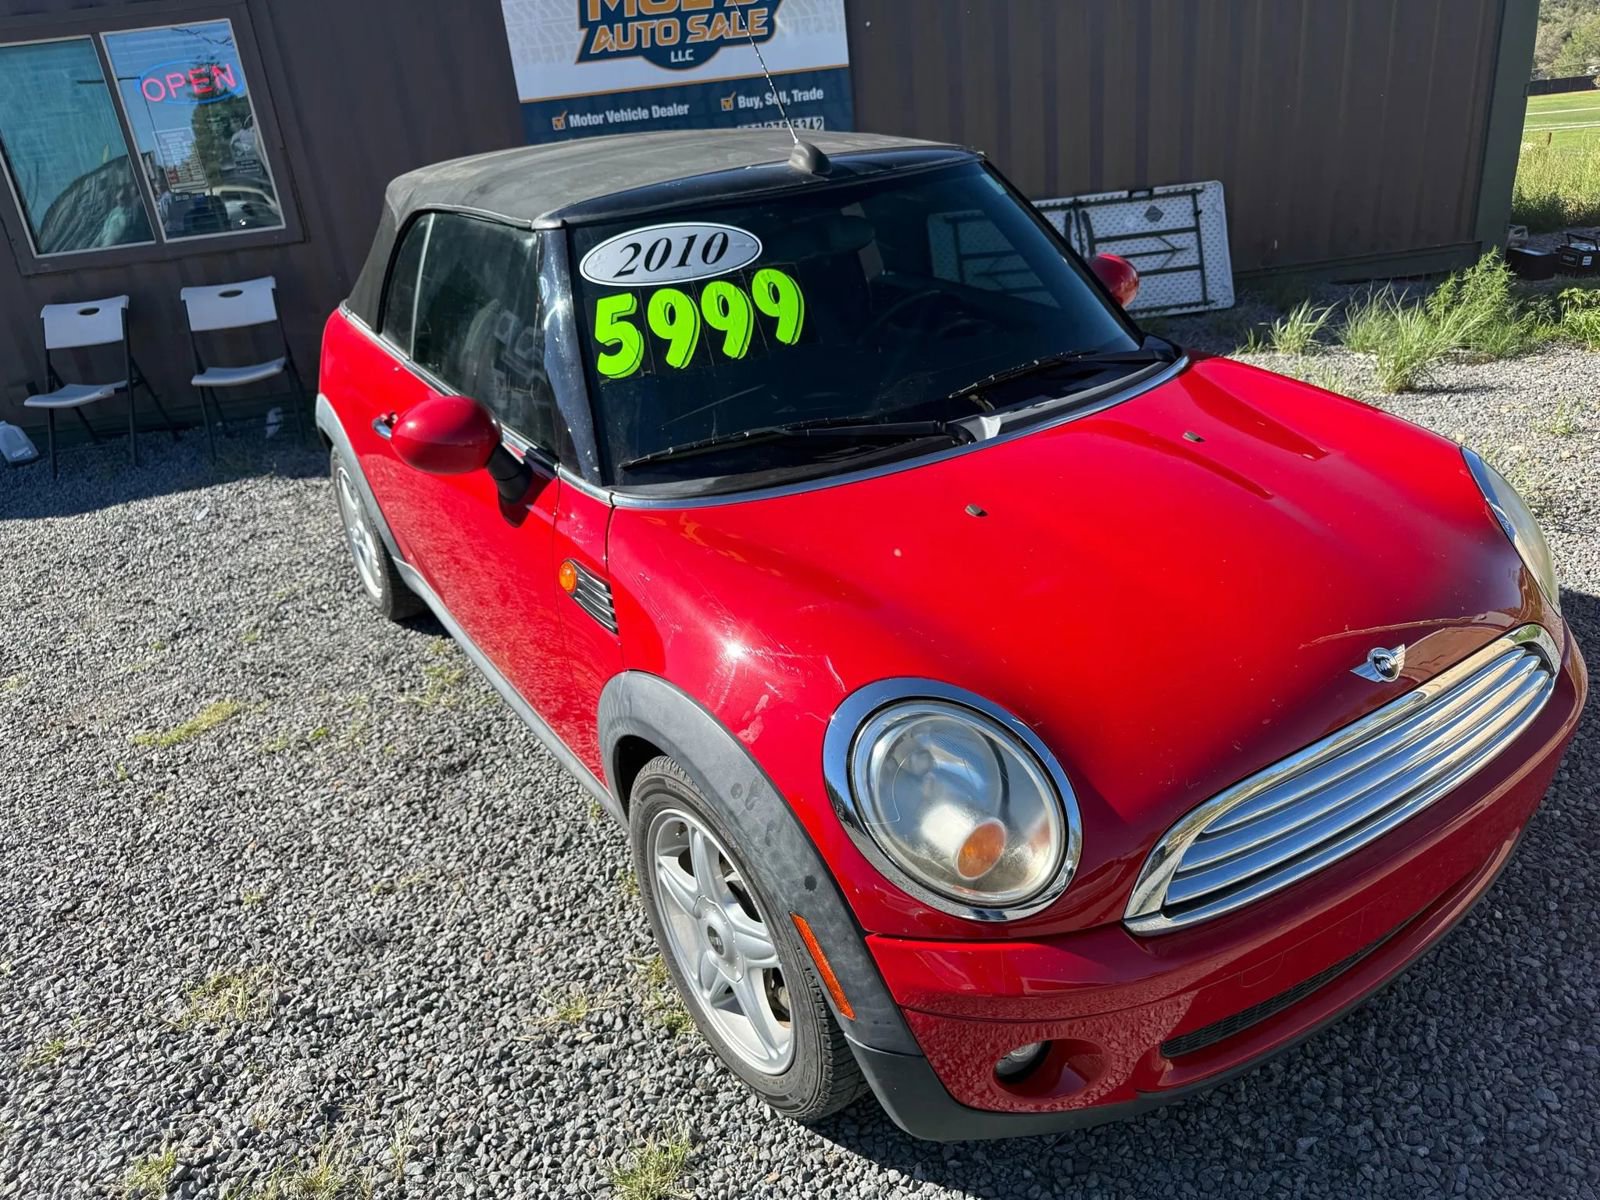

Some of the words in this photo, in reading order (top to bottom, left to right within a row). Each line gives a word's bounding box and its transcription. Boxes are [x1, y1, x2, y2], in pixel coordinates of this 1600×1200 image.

[589, 17, 681, 54] AUTO
[686, 7, 769, 44] SALE
[670, 49, 695, 63] LLC
[141, 63, 237, 102] OPEN
[737, 95, 763, 110] Buy,
[791, 86, 824, 103] Trade
[568, 112, 604, 128] Motor
[605, 106, 650, 124] Vehicle
[651, 102, 690, 118] Dealer
[613, 231, 729, 278] 2010
[594, 268, 805, 379] 5999
